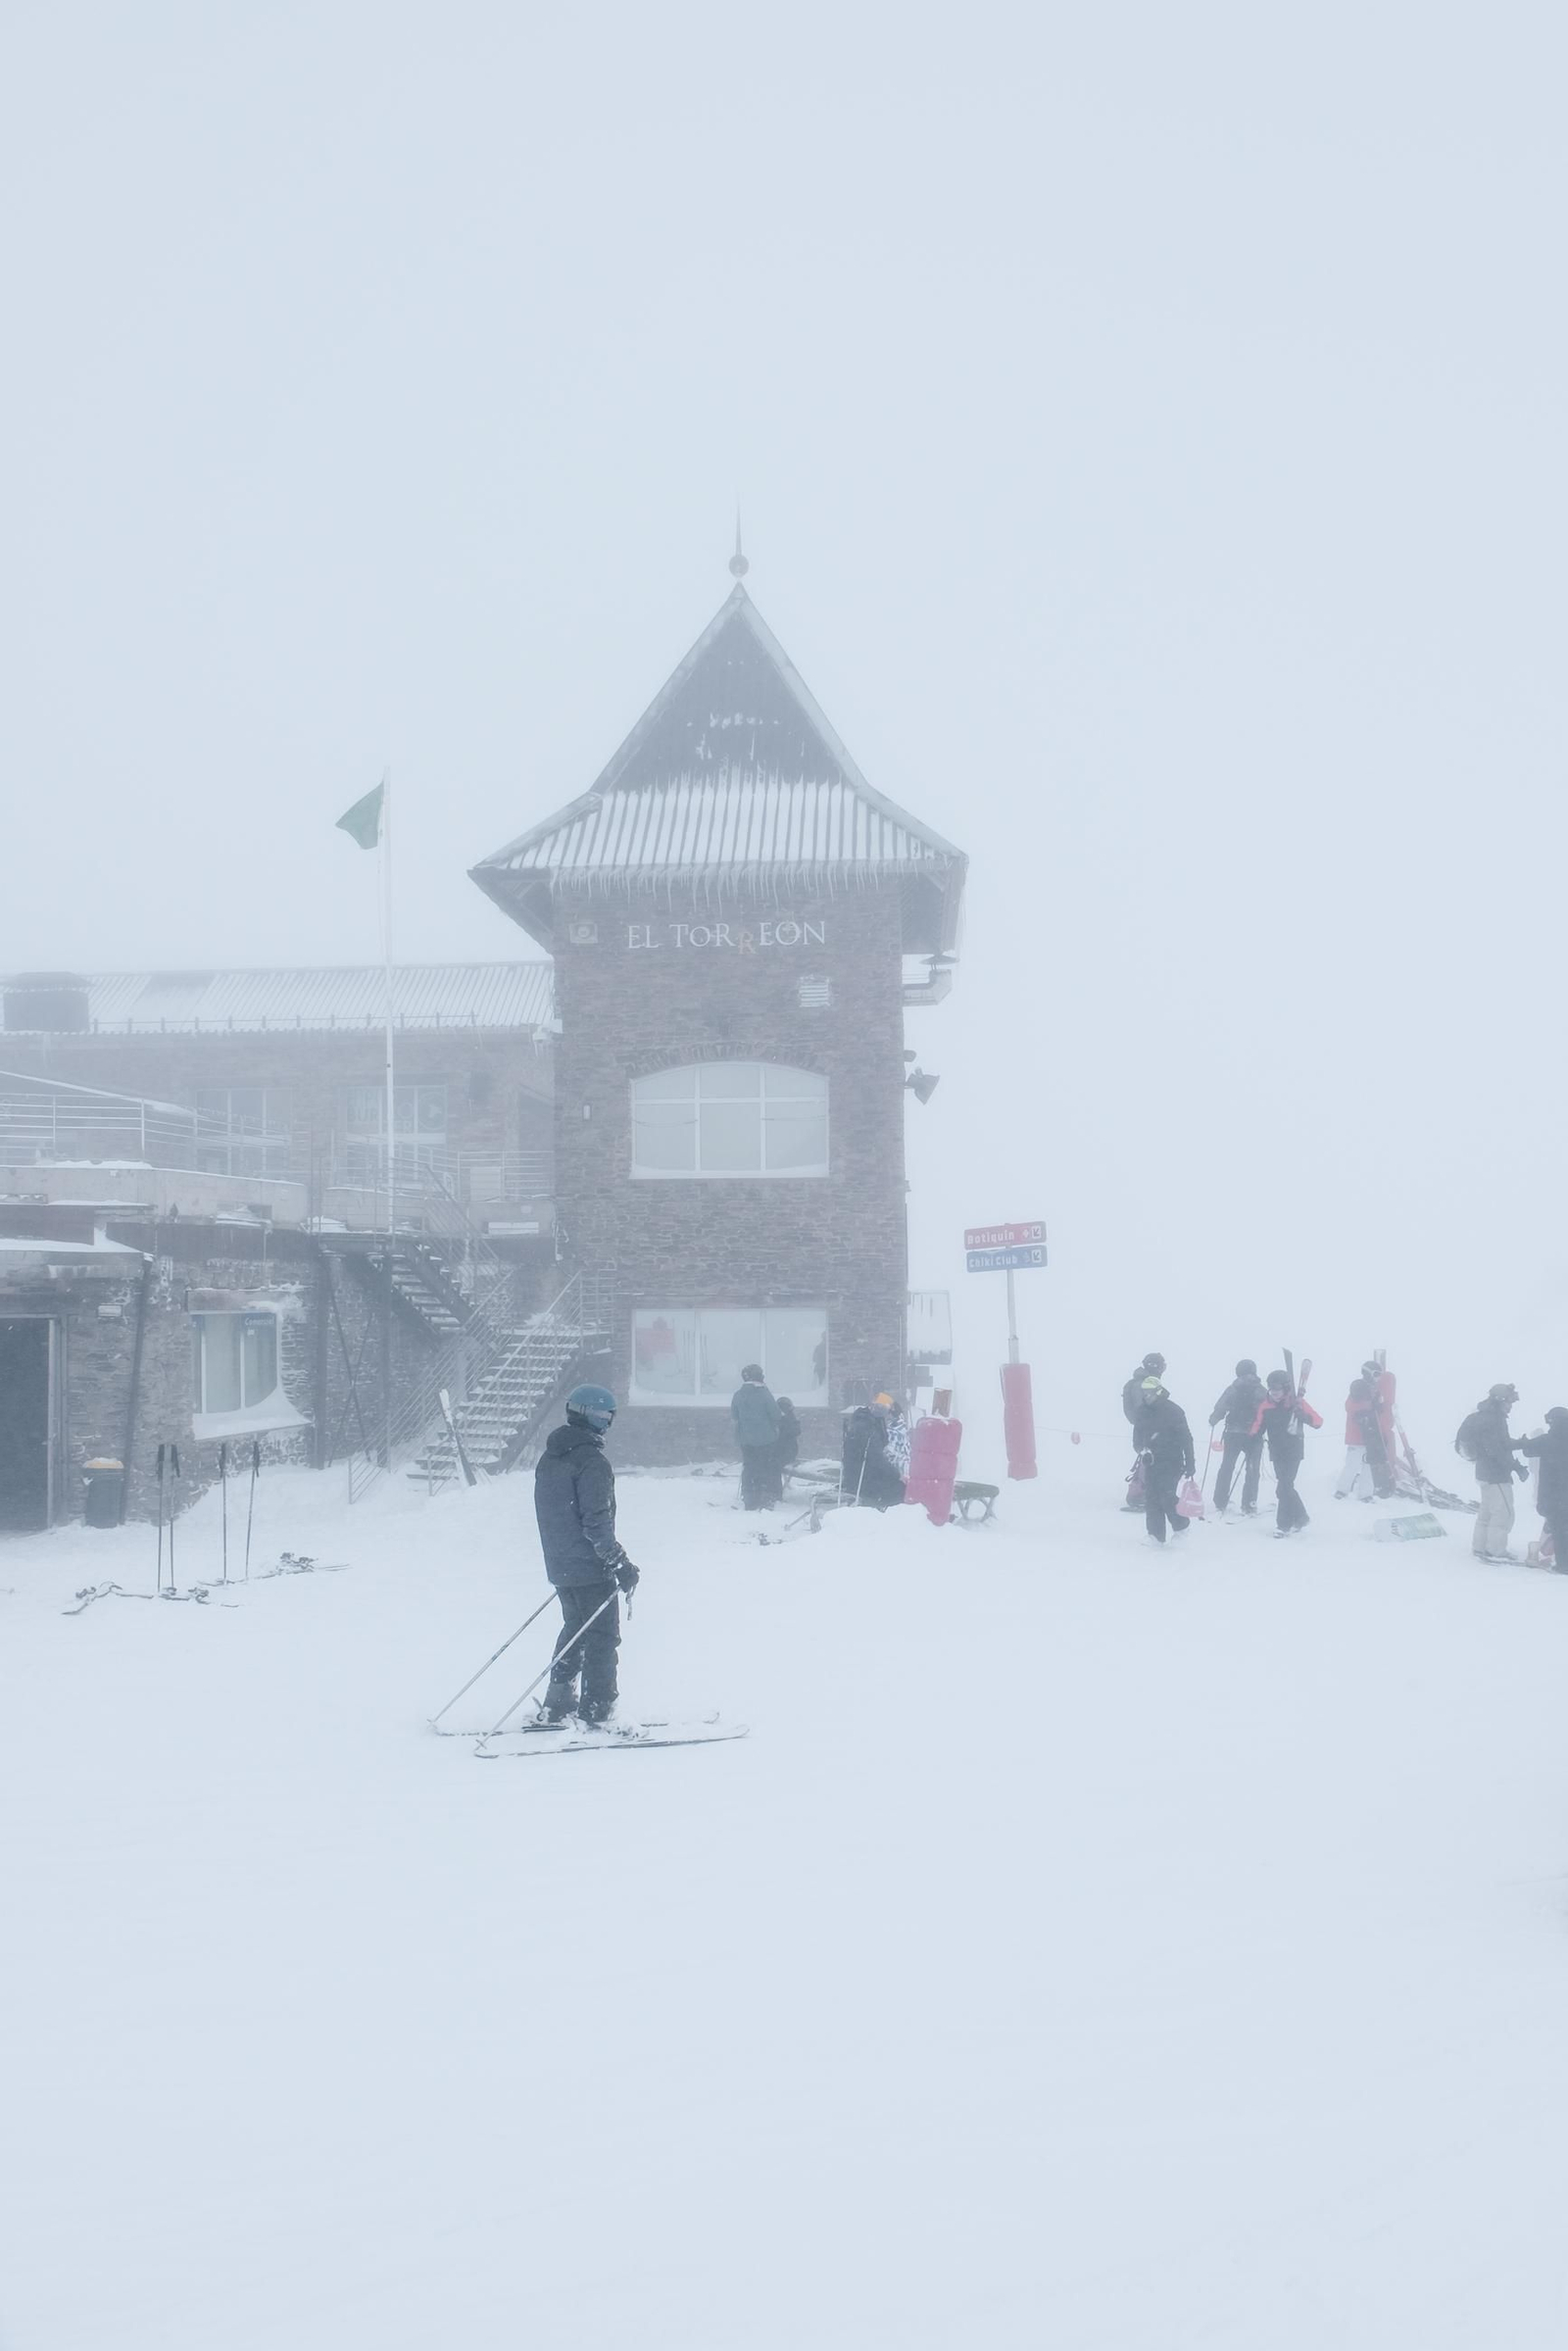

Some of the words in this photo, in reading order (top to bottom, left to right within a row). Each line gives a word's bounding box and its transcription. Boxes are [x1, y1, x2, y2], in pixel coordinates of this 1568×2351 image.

[627, 924, 660, 950] EL
[668, 922, 826, 955] TORREON
[995, 1254, 1018, 1266] Club
